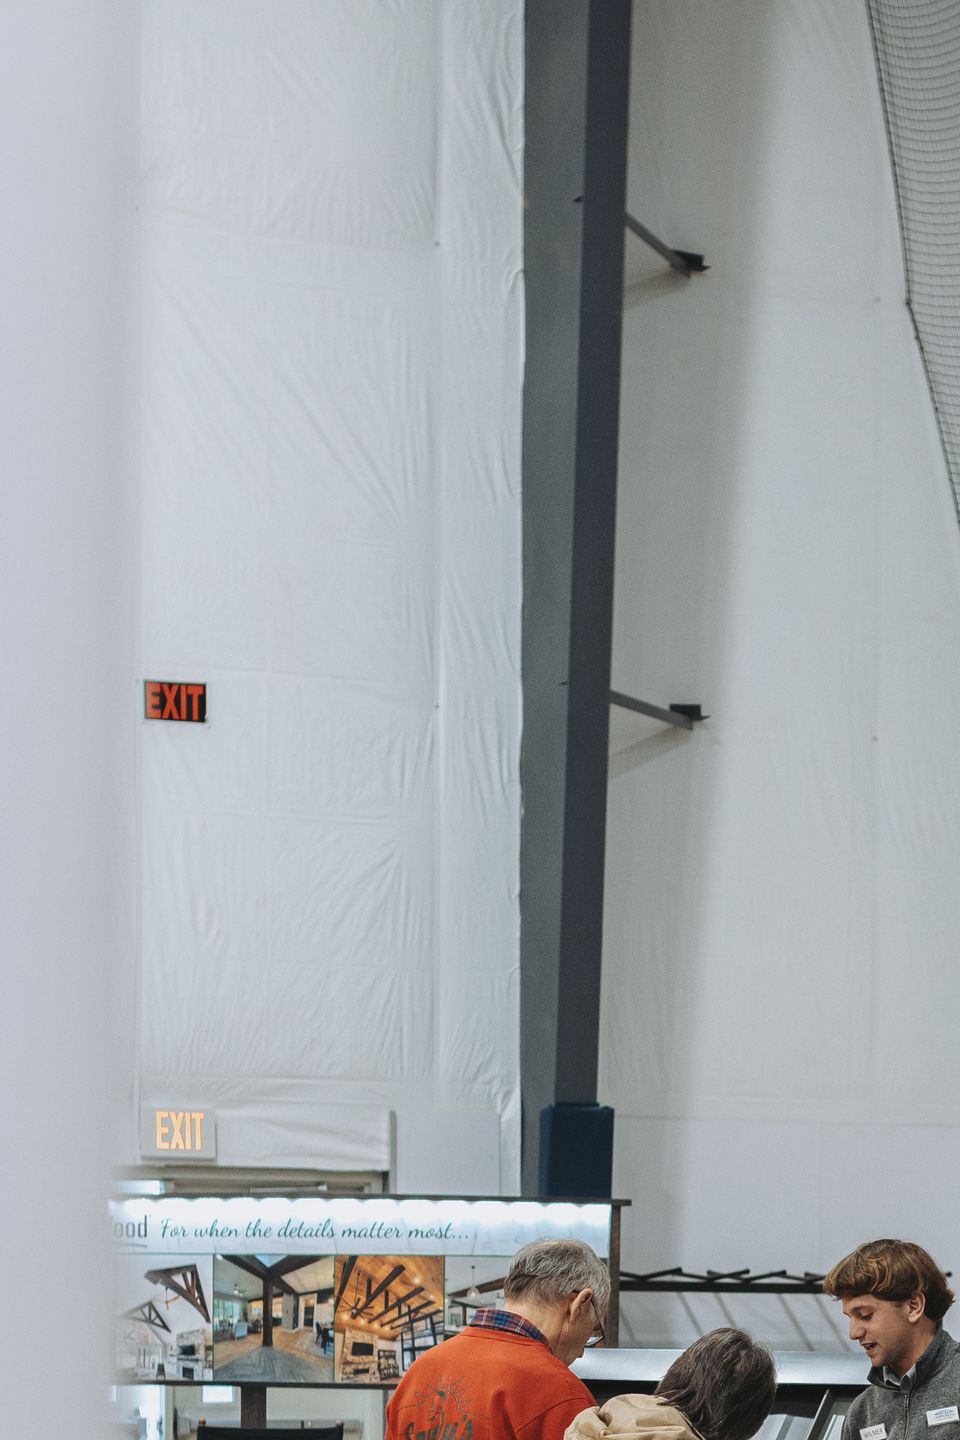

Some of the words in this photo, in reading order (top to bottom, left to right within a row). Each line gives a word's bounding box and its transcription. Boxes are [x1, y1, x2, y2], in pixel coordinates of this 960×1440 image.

[145, 682, 204, 721] EXIT
[155, 1110, 205, 1151] EXIT
[161, 1218, 188, 1239] For
[194, 1218, 239, 1238] when
[244, 1218, 273, 1238] the
[277, 1217, 336, 1239] details
[341, 1222, 404, 1239] matter
